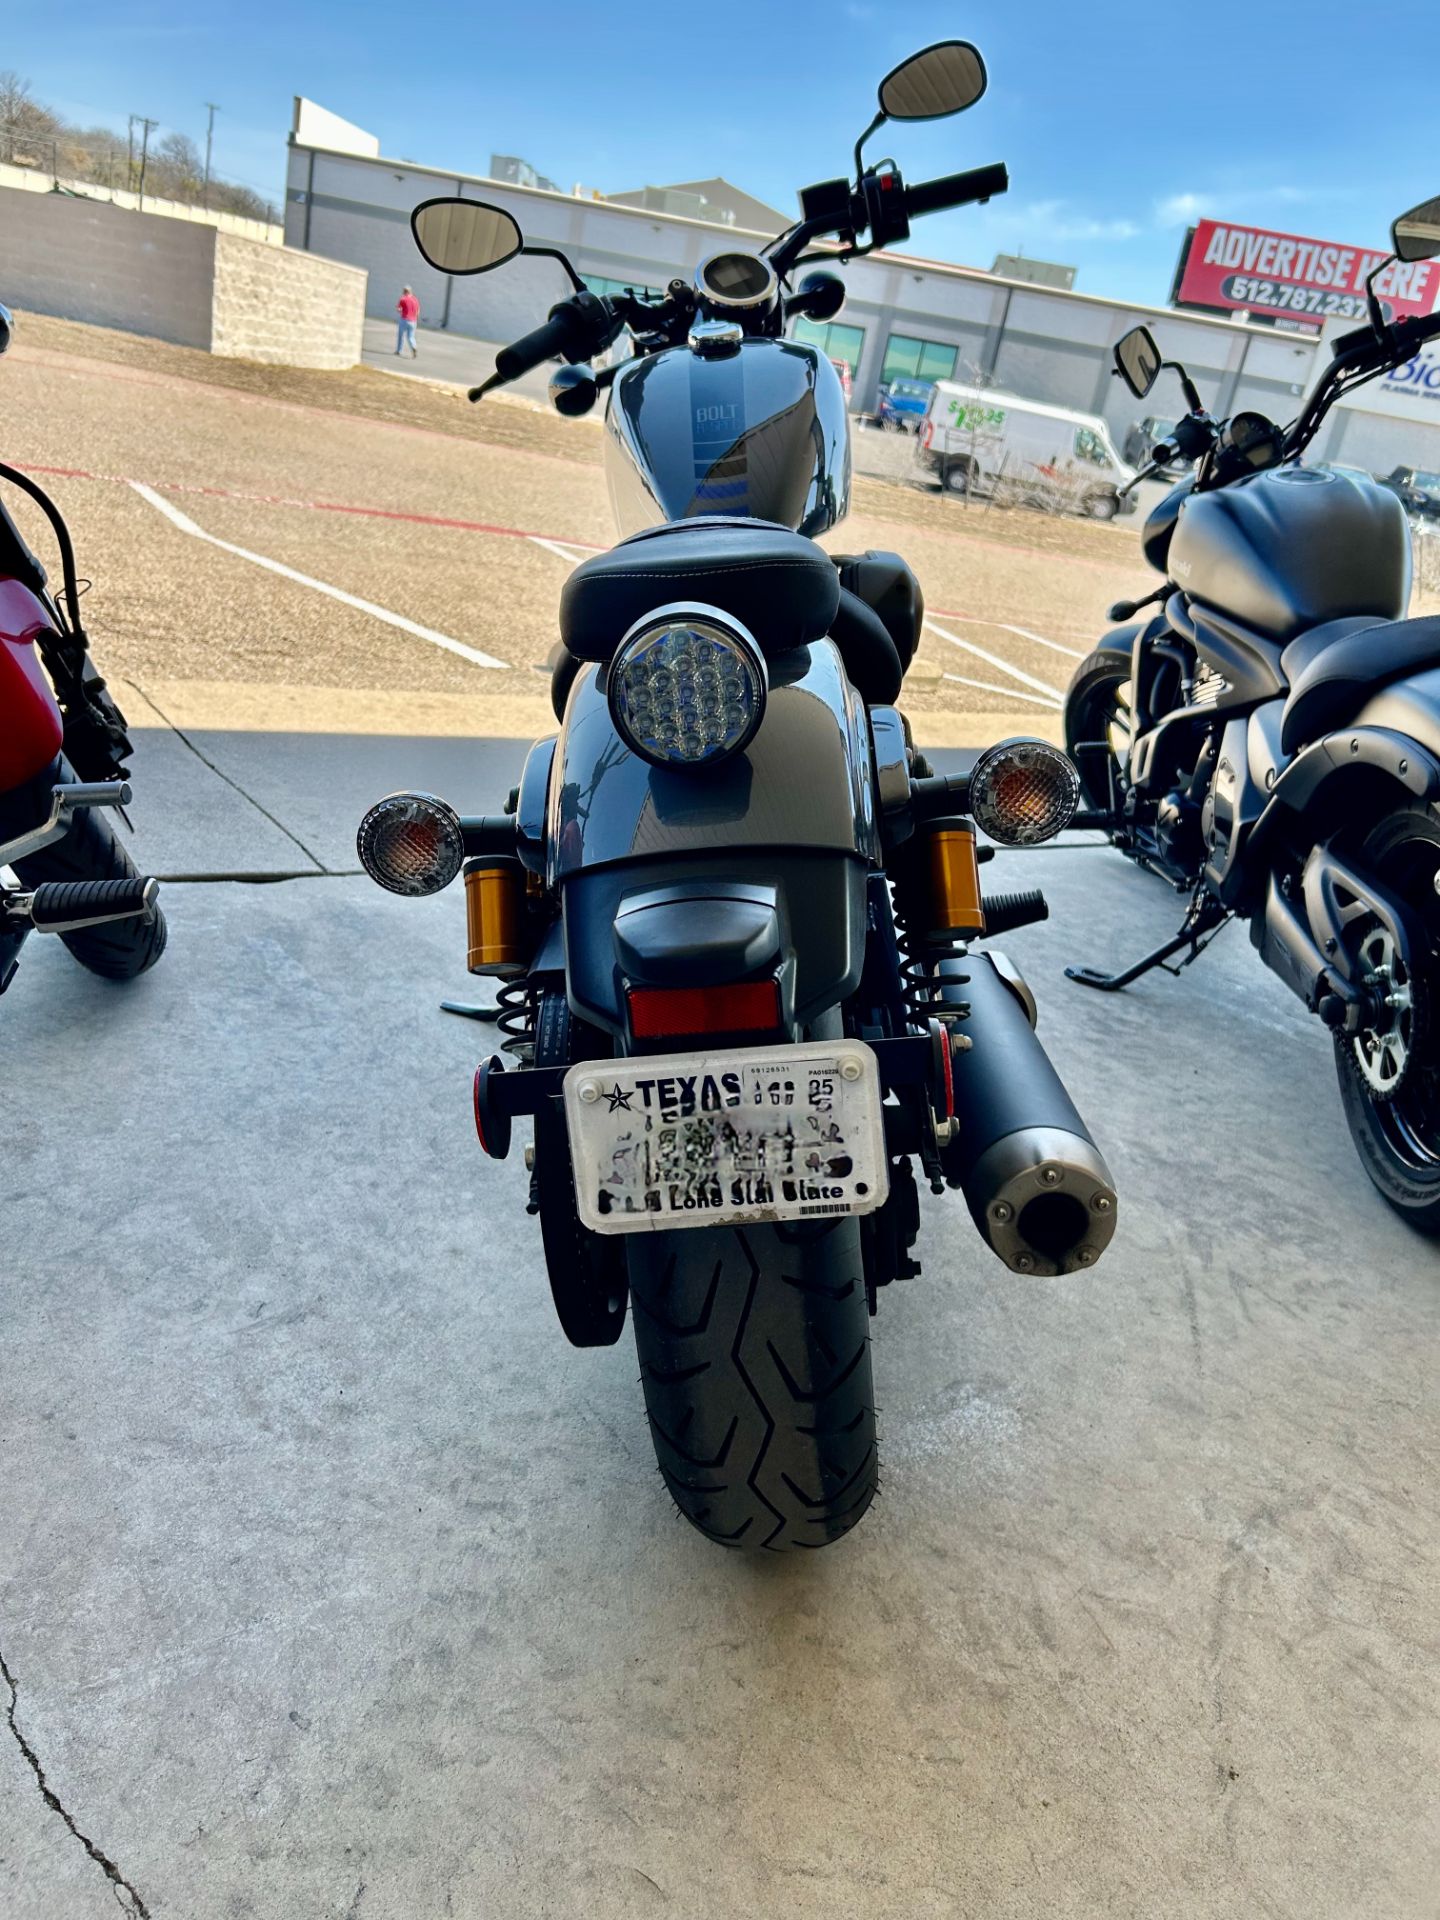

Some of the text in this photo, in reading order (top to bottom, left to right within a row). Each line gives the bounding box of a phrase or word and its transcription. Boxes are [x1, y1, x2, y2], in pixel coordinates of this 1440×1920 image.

[1203, 227, 1431, 302] ADVERTISE HERE
[1230, 278, 1370, 319] 512.787.237
[696, 404, 738, 423] BOLT
[635, 1073, 741, 1111] TEXAS
[669, 1184, 724, 1211] Lone
